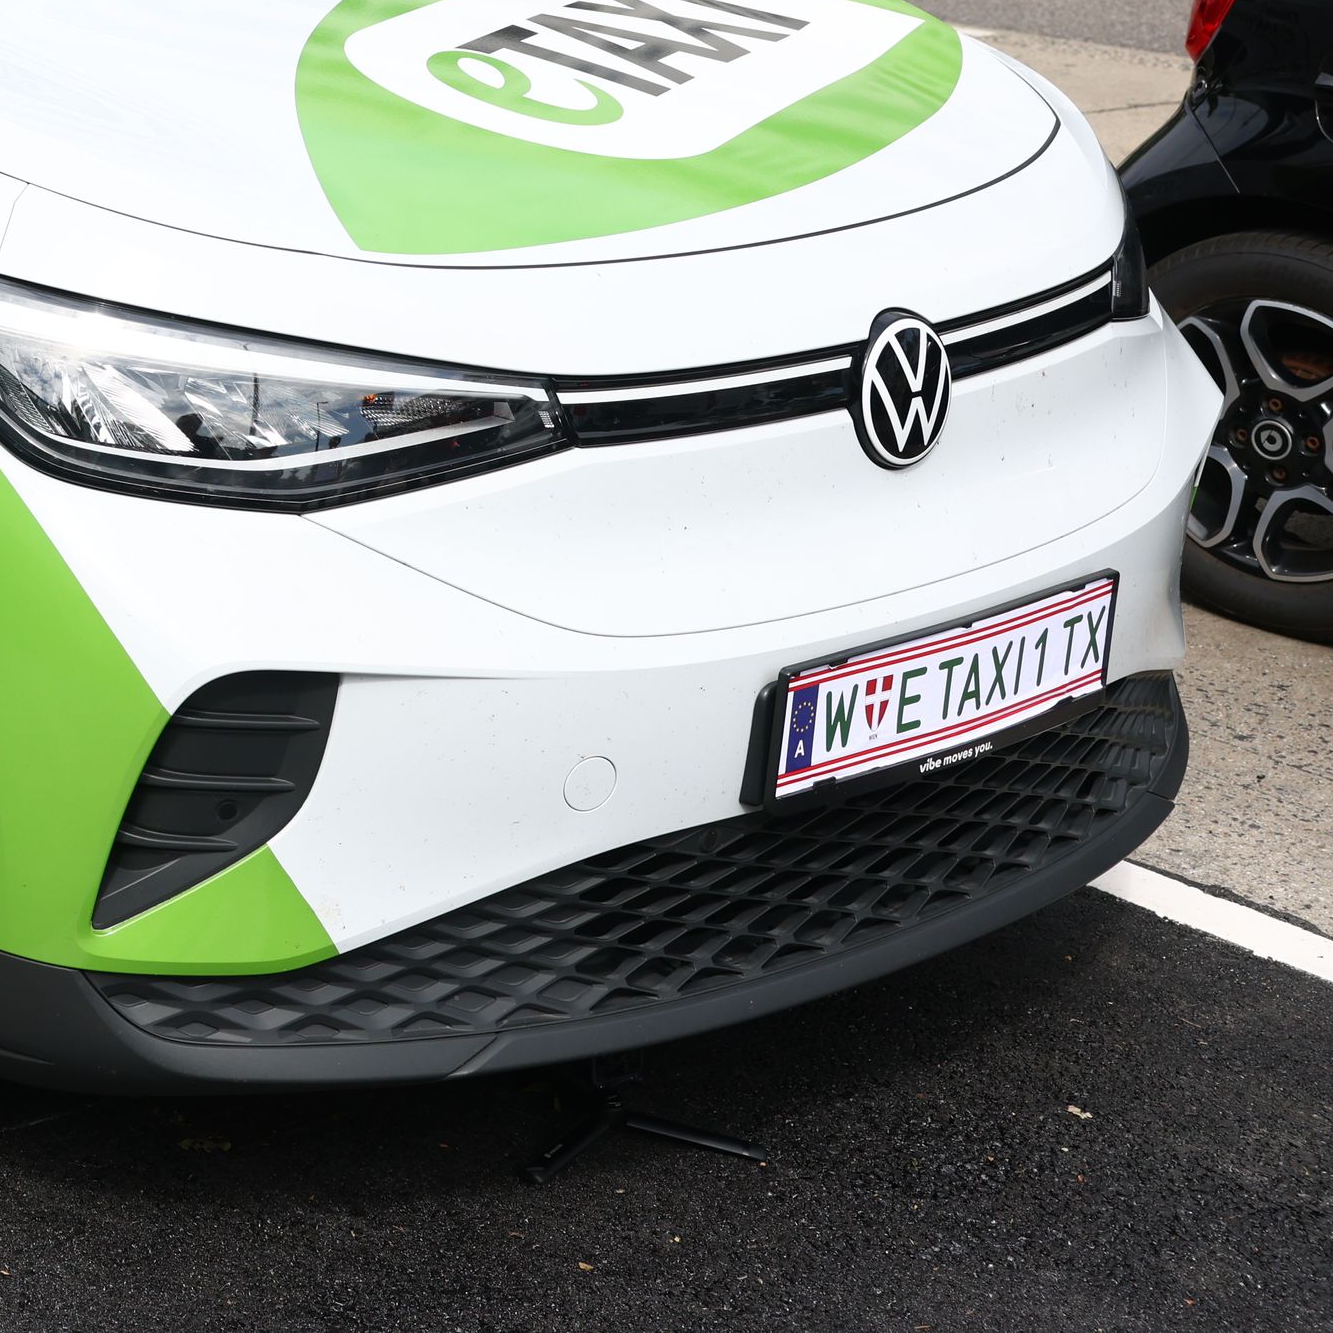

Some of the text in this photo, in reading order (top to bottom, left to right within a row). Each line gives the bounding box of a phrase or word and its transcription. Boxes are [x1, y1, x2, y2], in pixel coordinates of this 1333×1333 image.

[794, 739, 805, 758] A
[825, 682, 859, 753] W
[919, 741, 993, 773] vibe moves you.
